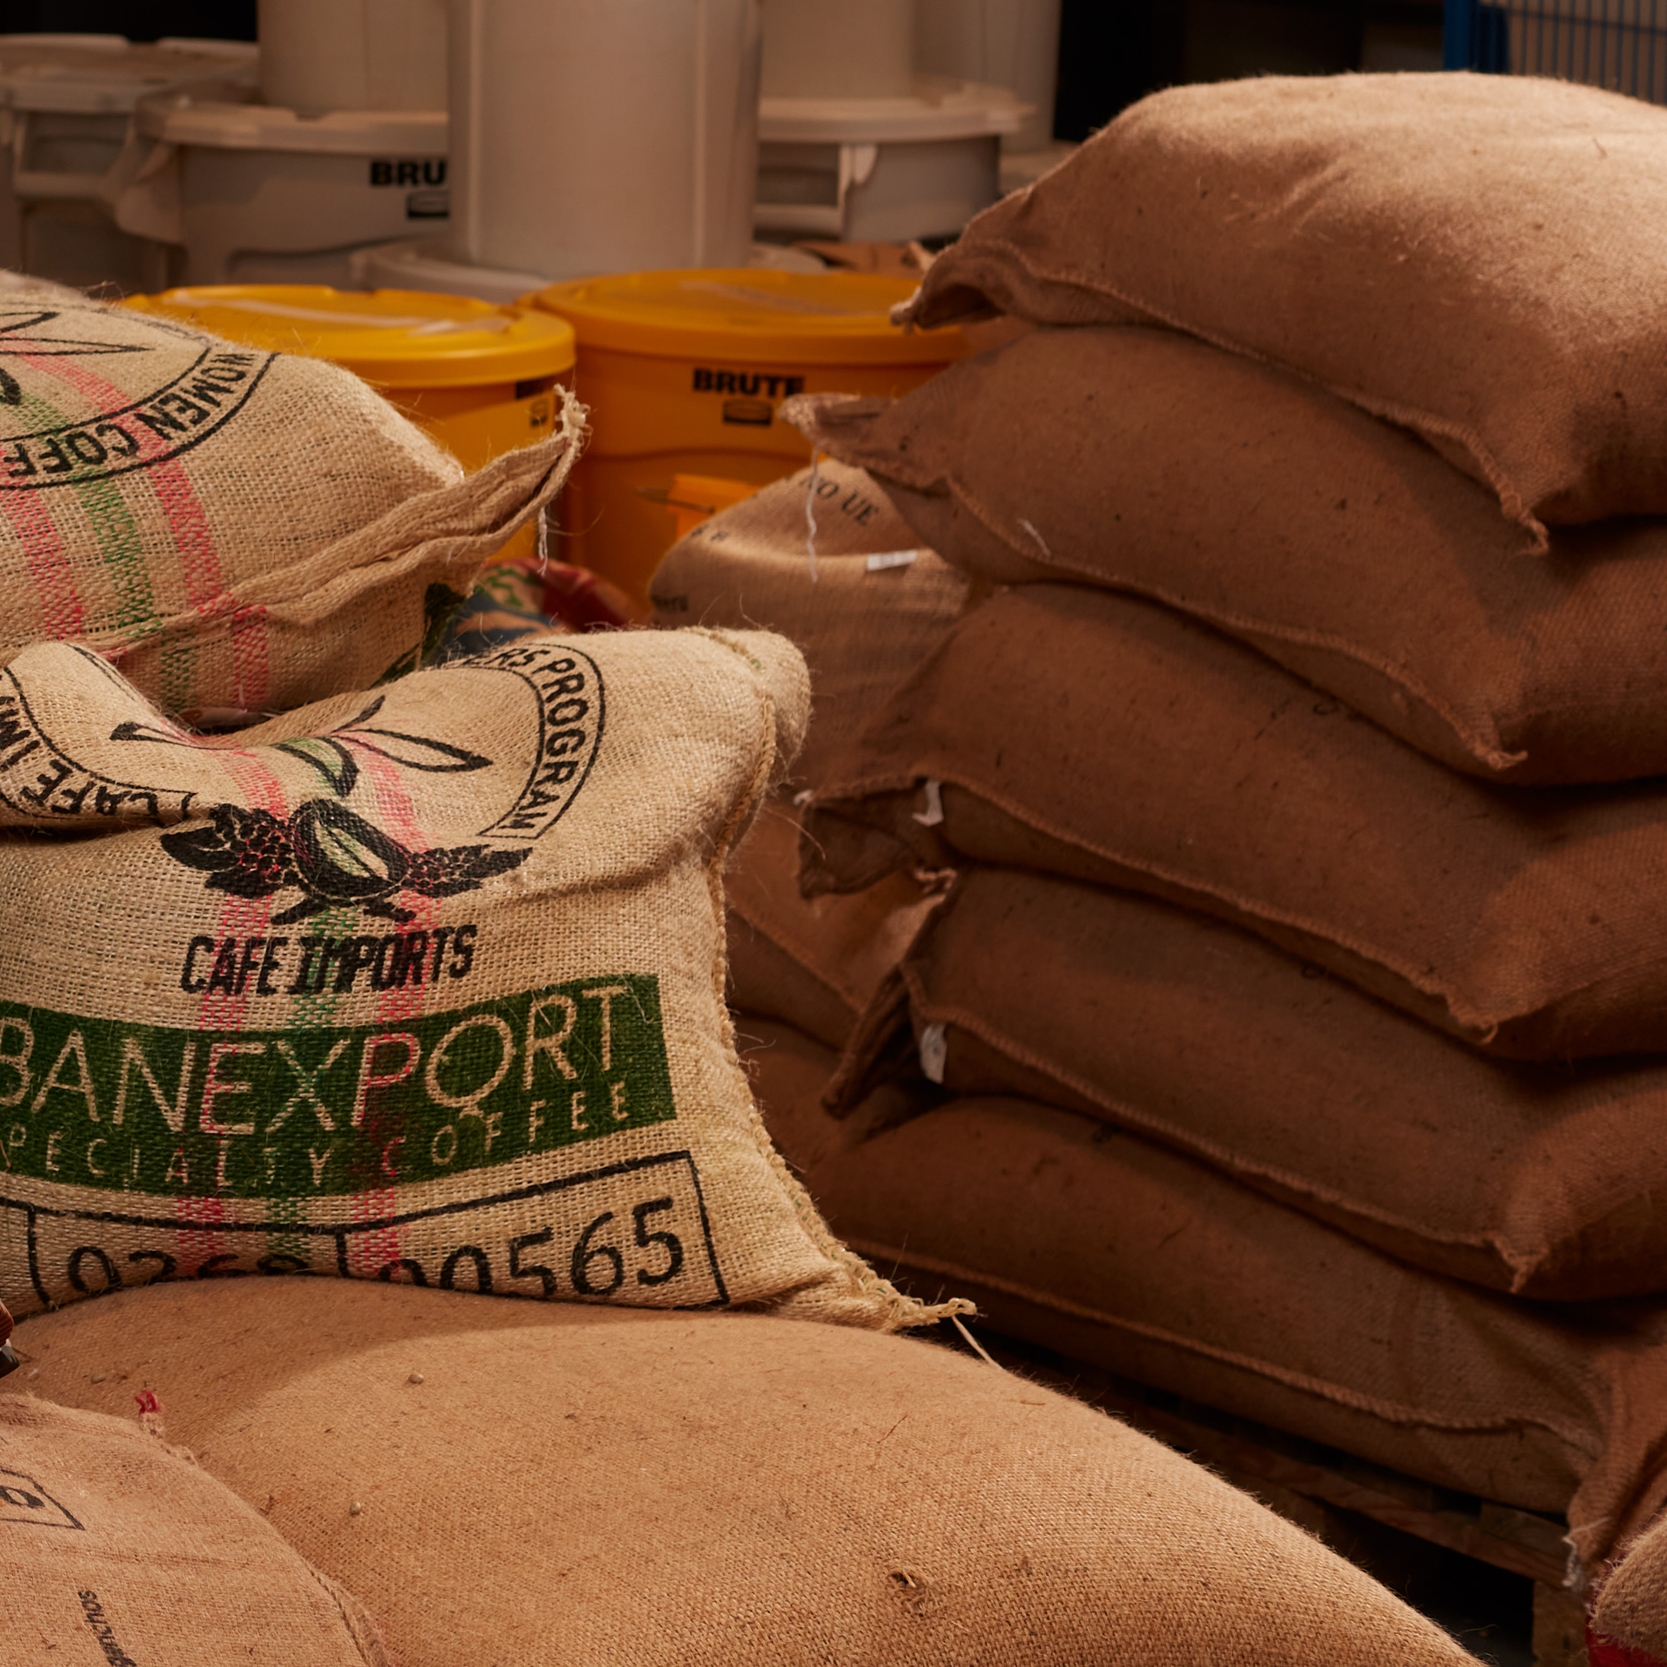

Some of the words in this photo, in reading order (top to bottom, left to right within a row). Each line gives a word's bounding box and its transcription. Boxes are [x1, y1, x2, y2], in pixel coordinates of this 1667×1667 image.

[370, 160, 446, 185] BRU
[693, 368, 805, 397] BRUTE
[498, 657, 589, 830] PROGRAM
[180, 935, 288, 995] CAFE
[380, 1079, 632, 1179] COFFEE
